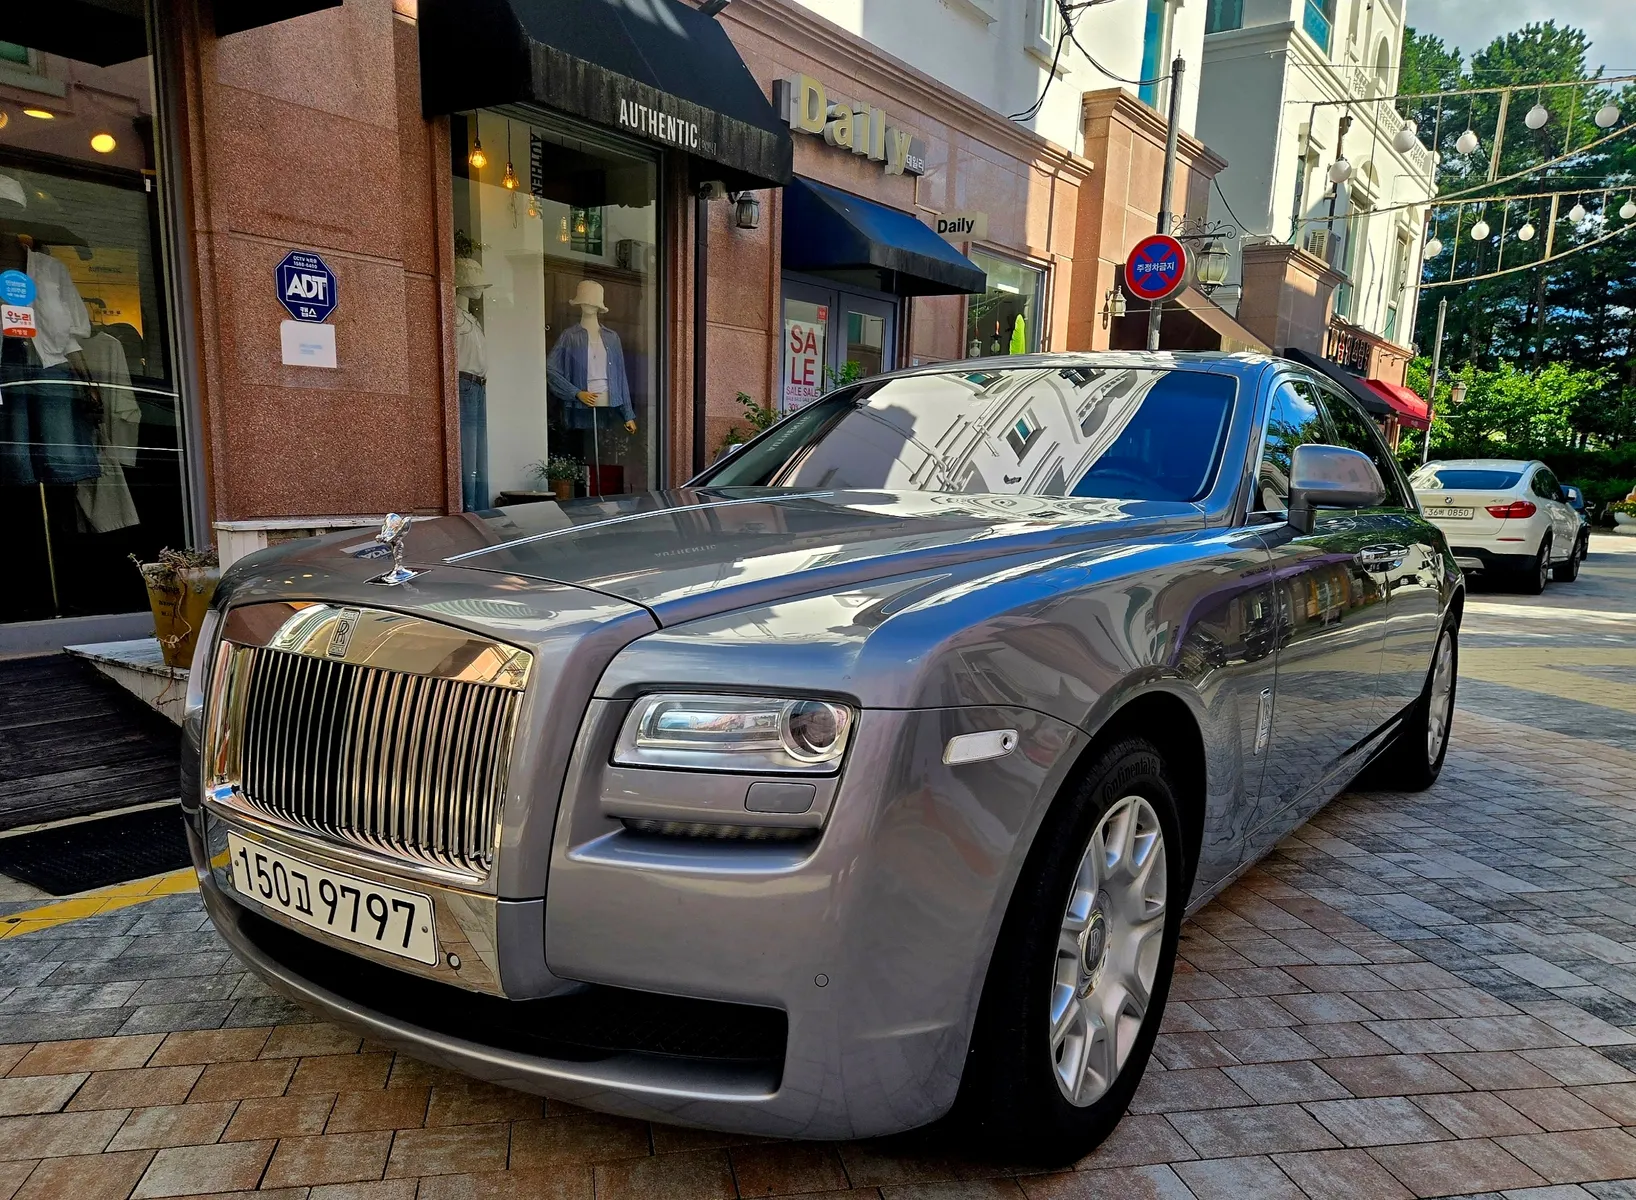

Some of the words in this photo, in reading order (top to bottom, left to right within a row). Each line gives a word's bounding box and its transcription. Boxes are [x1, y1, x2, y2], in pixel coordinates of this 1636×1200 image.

[619, 98, 698, 149] AUTHENTIC
[790, 73, 912, 175] Daily
[937, 217, 975, 234] Daily
[292, 255, 305, 263] CCTV
[1136, 261, 1175, 273] 주정차금지
[286, 273, 327, 300] ADT
[299, 306, 318, 318] 캡스
[790, 324, 818, 356] SA
[791, 356, 815, 387] LE
[786, 386, 802, 397] SALE
[802, 387, 819, 398] SALE
[1447, 508, 1469, 517] 0850
[239, 846, 314, 917] 150고
[318, 878, 416, 949] 9797
